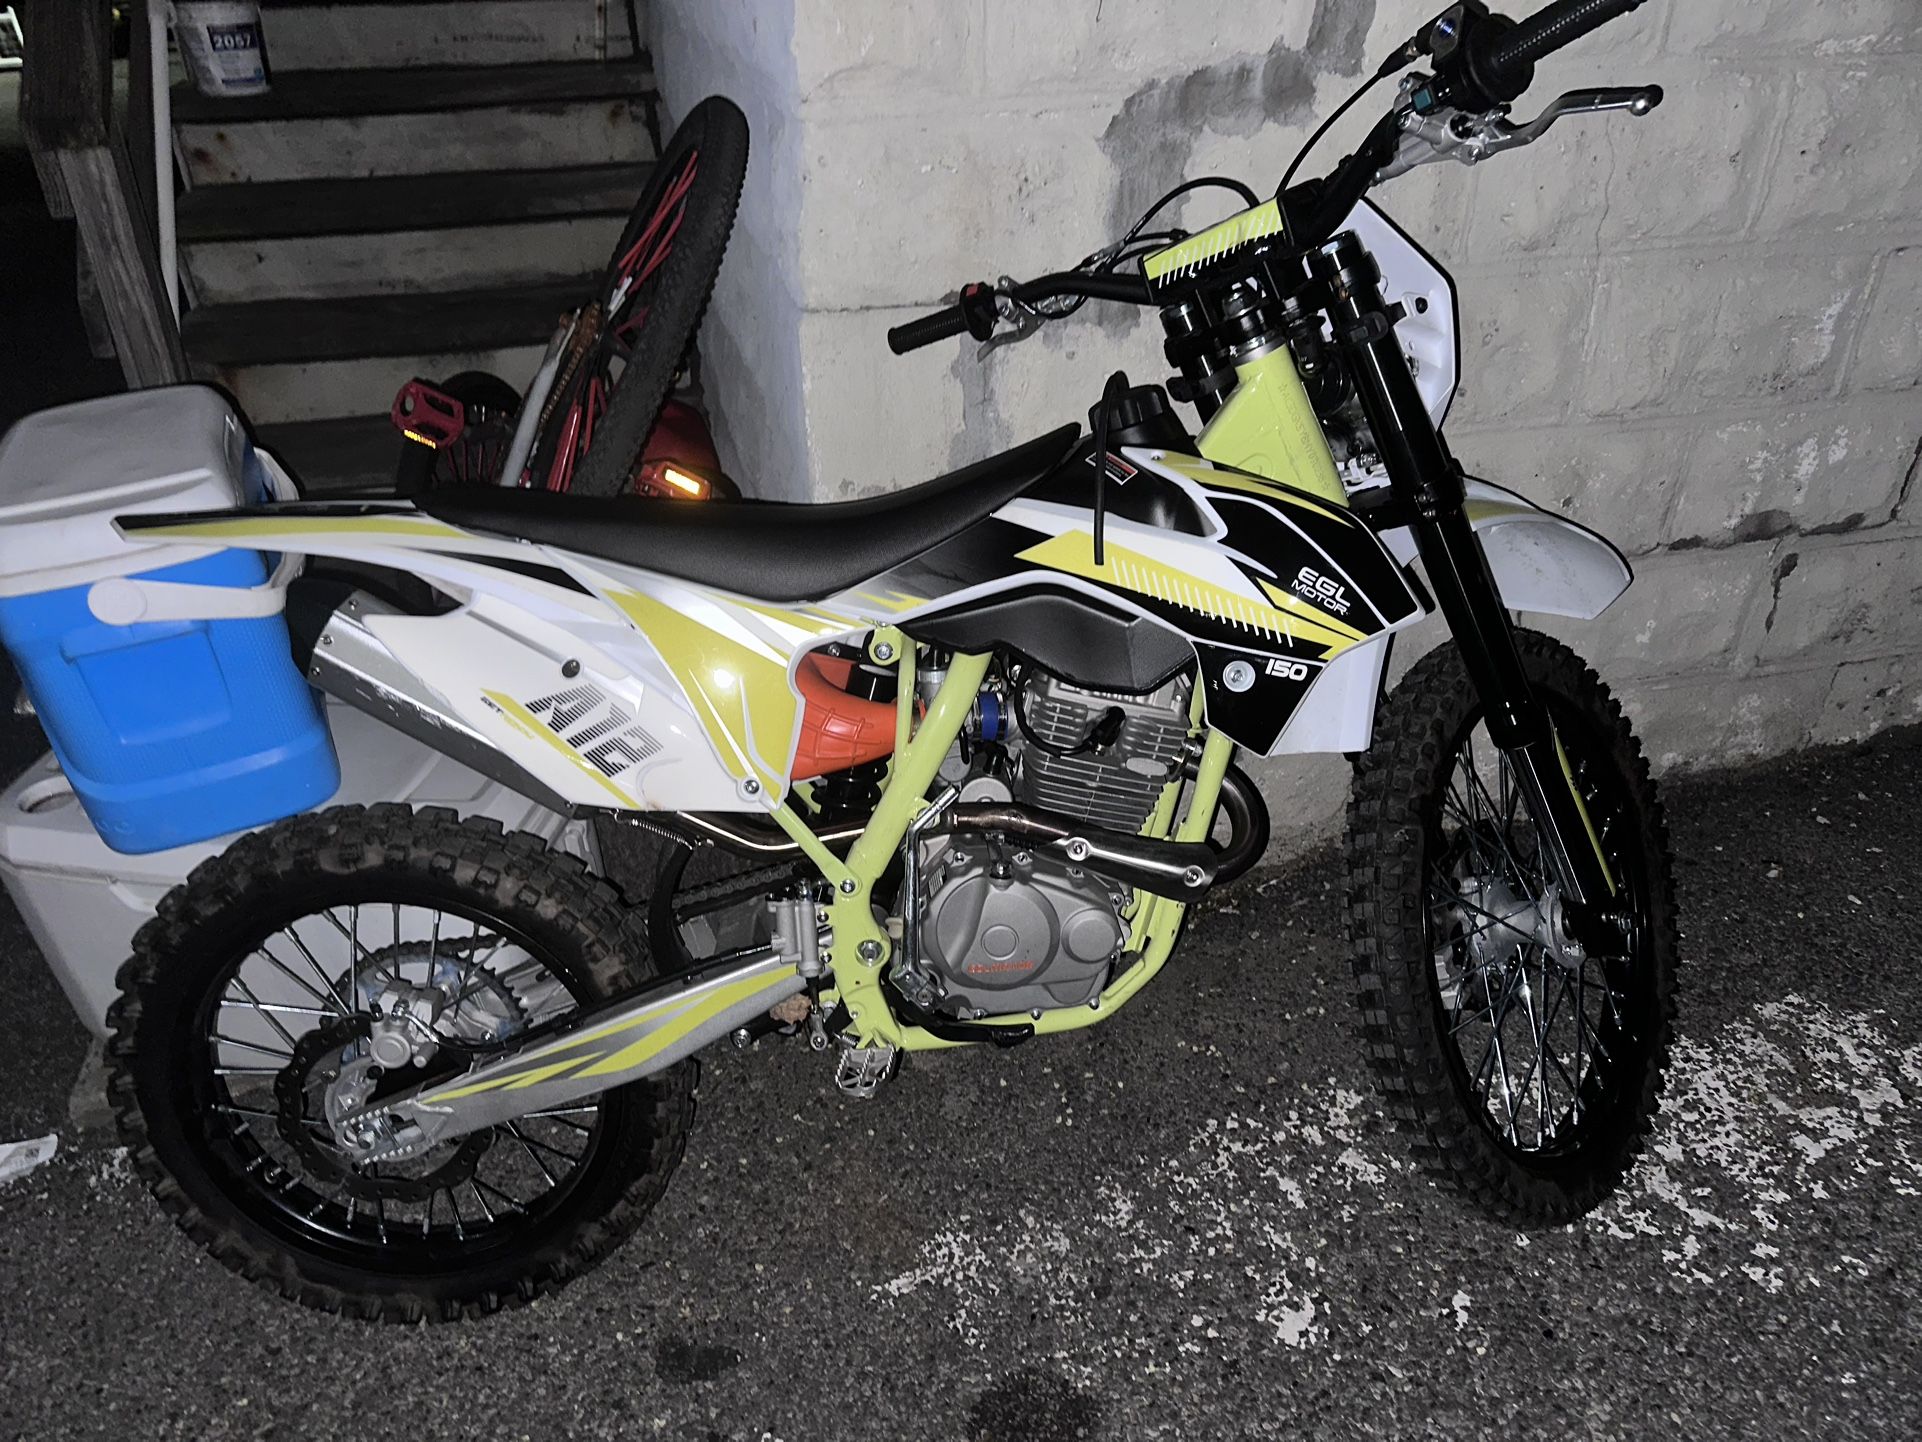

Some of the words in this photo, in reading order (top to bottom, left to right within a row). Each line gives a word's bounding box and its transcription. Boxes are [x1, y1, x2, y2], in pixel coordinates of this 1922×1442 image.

[1291, 579, 1348, 616] MOTOR
[1298, 566, 1351, 608] EGL
[1265, 658, 1308, 682] 150
